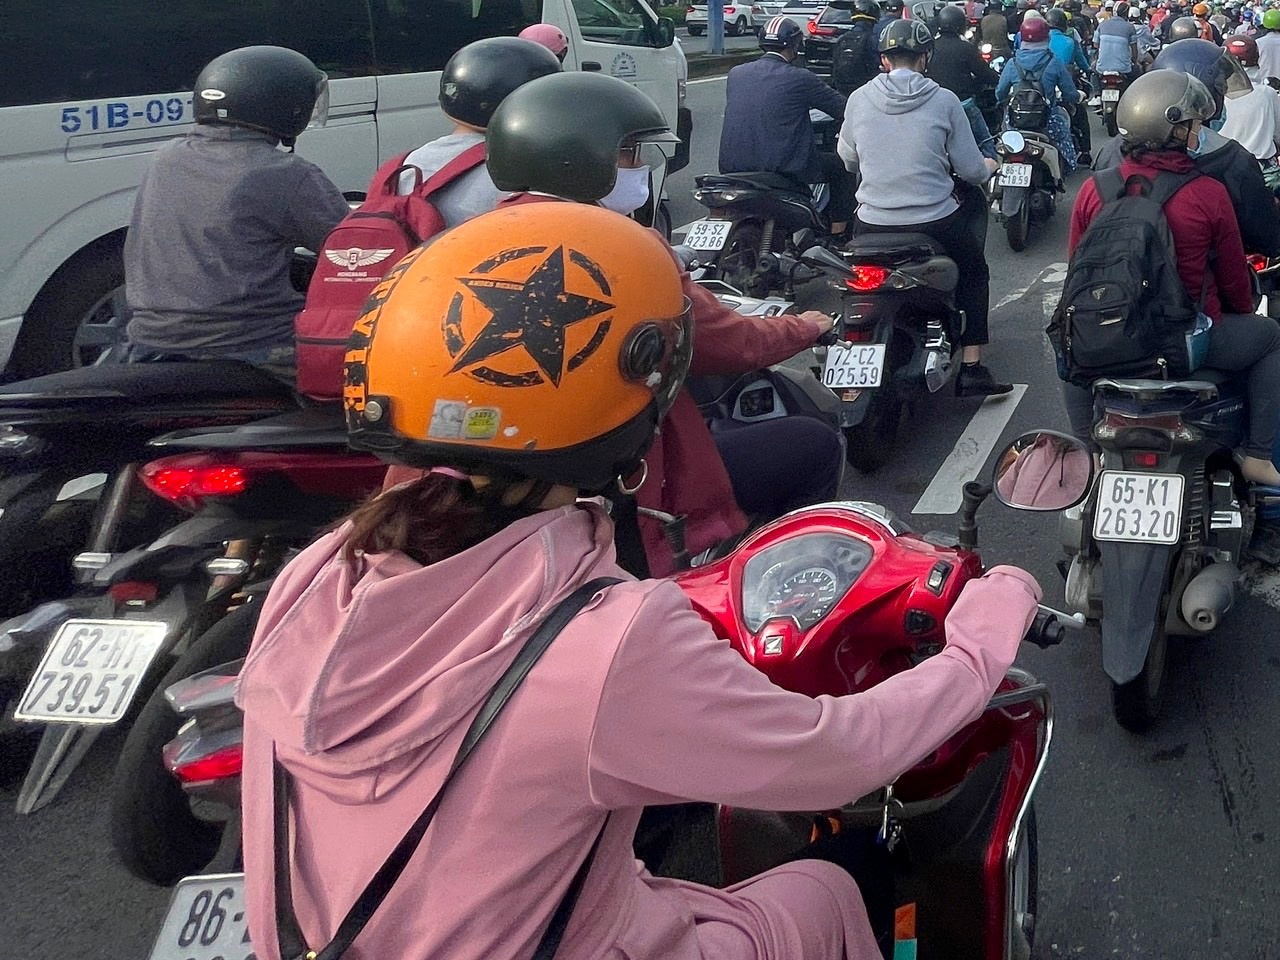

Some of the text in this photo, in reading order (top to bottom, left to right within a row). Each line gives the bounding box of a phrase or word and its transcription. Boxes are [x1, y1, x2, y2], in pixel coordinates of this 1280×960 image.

[60, 98, 193, 133] 51B-09
[688, 236, 723, 247] 923.86
[695, 224, 725, 235] 59-S2
[835, 347, 876, 365] 72-C2
[826, 367, 879, 385] 025.59
[1112, 477, 1169, 506] 65-K1
[1100, 507, 1175, 538] 263.20
[27, 671, 135, 715] 739.51
[178, 887, 252, 947] 86-
